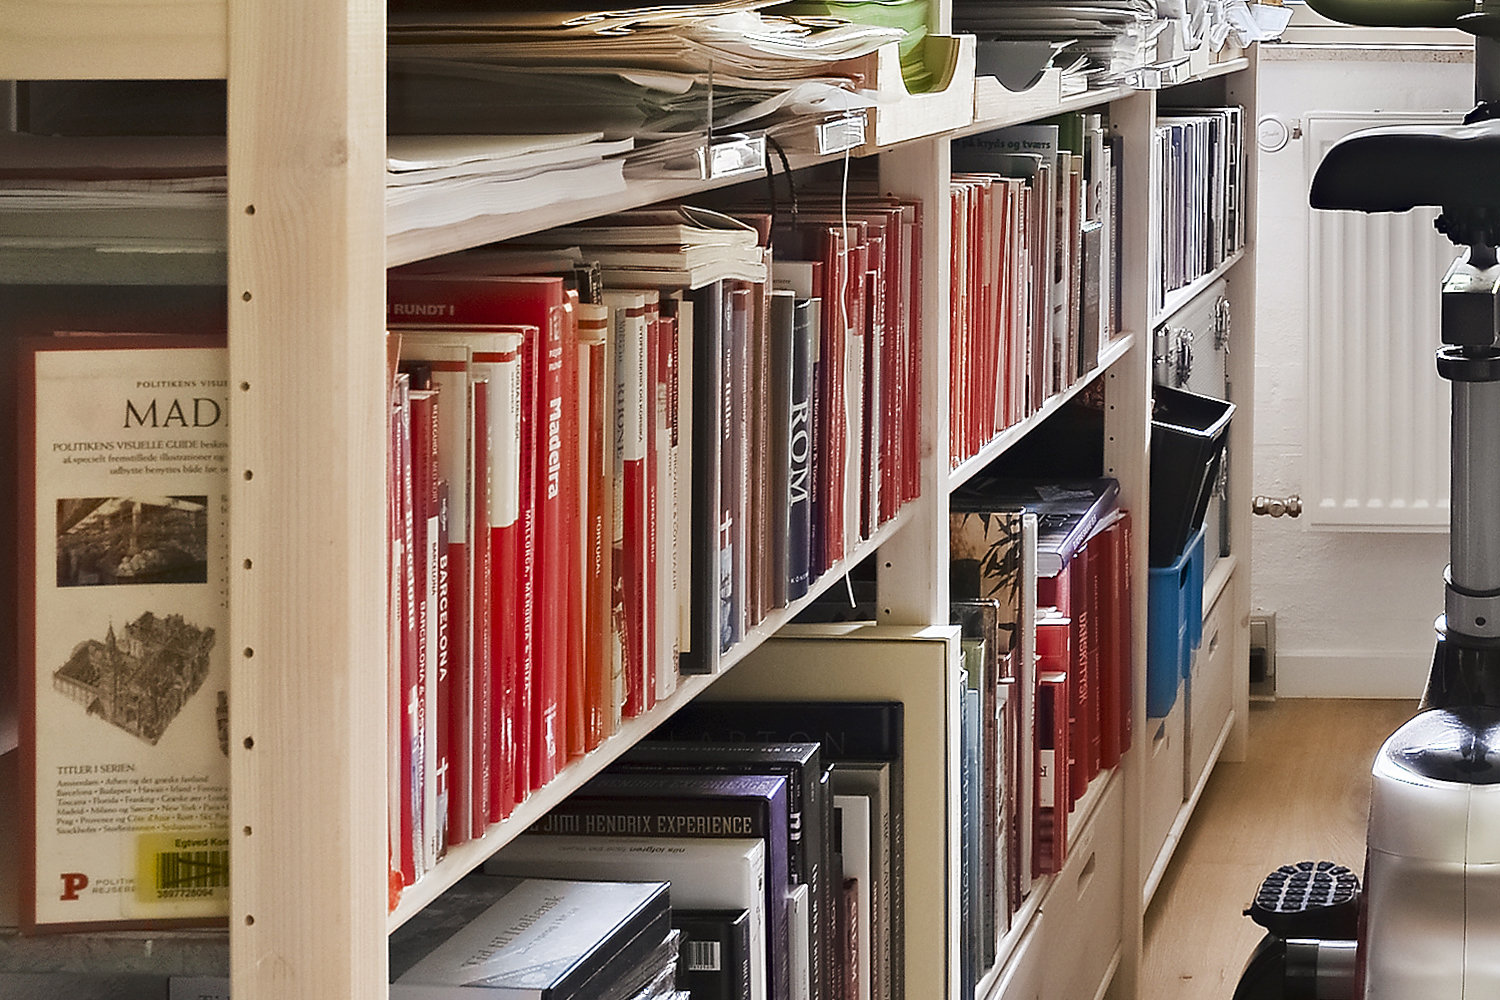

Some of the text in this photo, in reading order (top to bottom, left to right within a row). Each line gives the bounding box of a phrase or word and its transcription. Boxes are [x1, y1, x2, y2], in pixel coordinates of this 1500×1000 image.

[394, 304, 446, 315] RUNDT
[724, 382, 732, 440] Italien
[53, 441, 199, 451] POLITIKENS VISUELLE GUIDE
[547, 397, 561, 500] Madeira
[790, 398, 809, 507] ROM
[73, 455, 106, 464] specielt
[673, 509, 677, 519] &
[1078, 612, 1088, 705] DANSK/TYSK
[56, 765, 94, 775] TITLER
[95, 765, 98, 774] I
[544, 815, 753, 834] JIMI HENDRIX EXPERIENCE
[175, 839, 208, 848] Egtved
[60, 873, 88, 901] P
[508, 894, 565, 937] Italiensk
